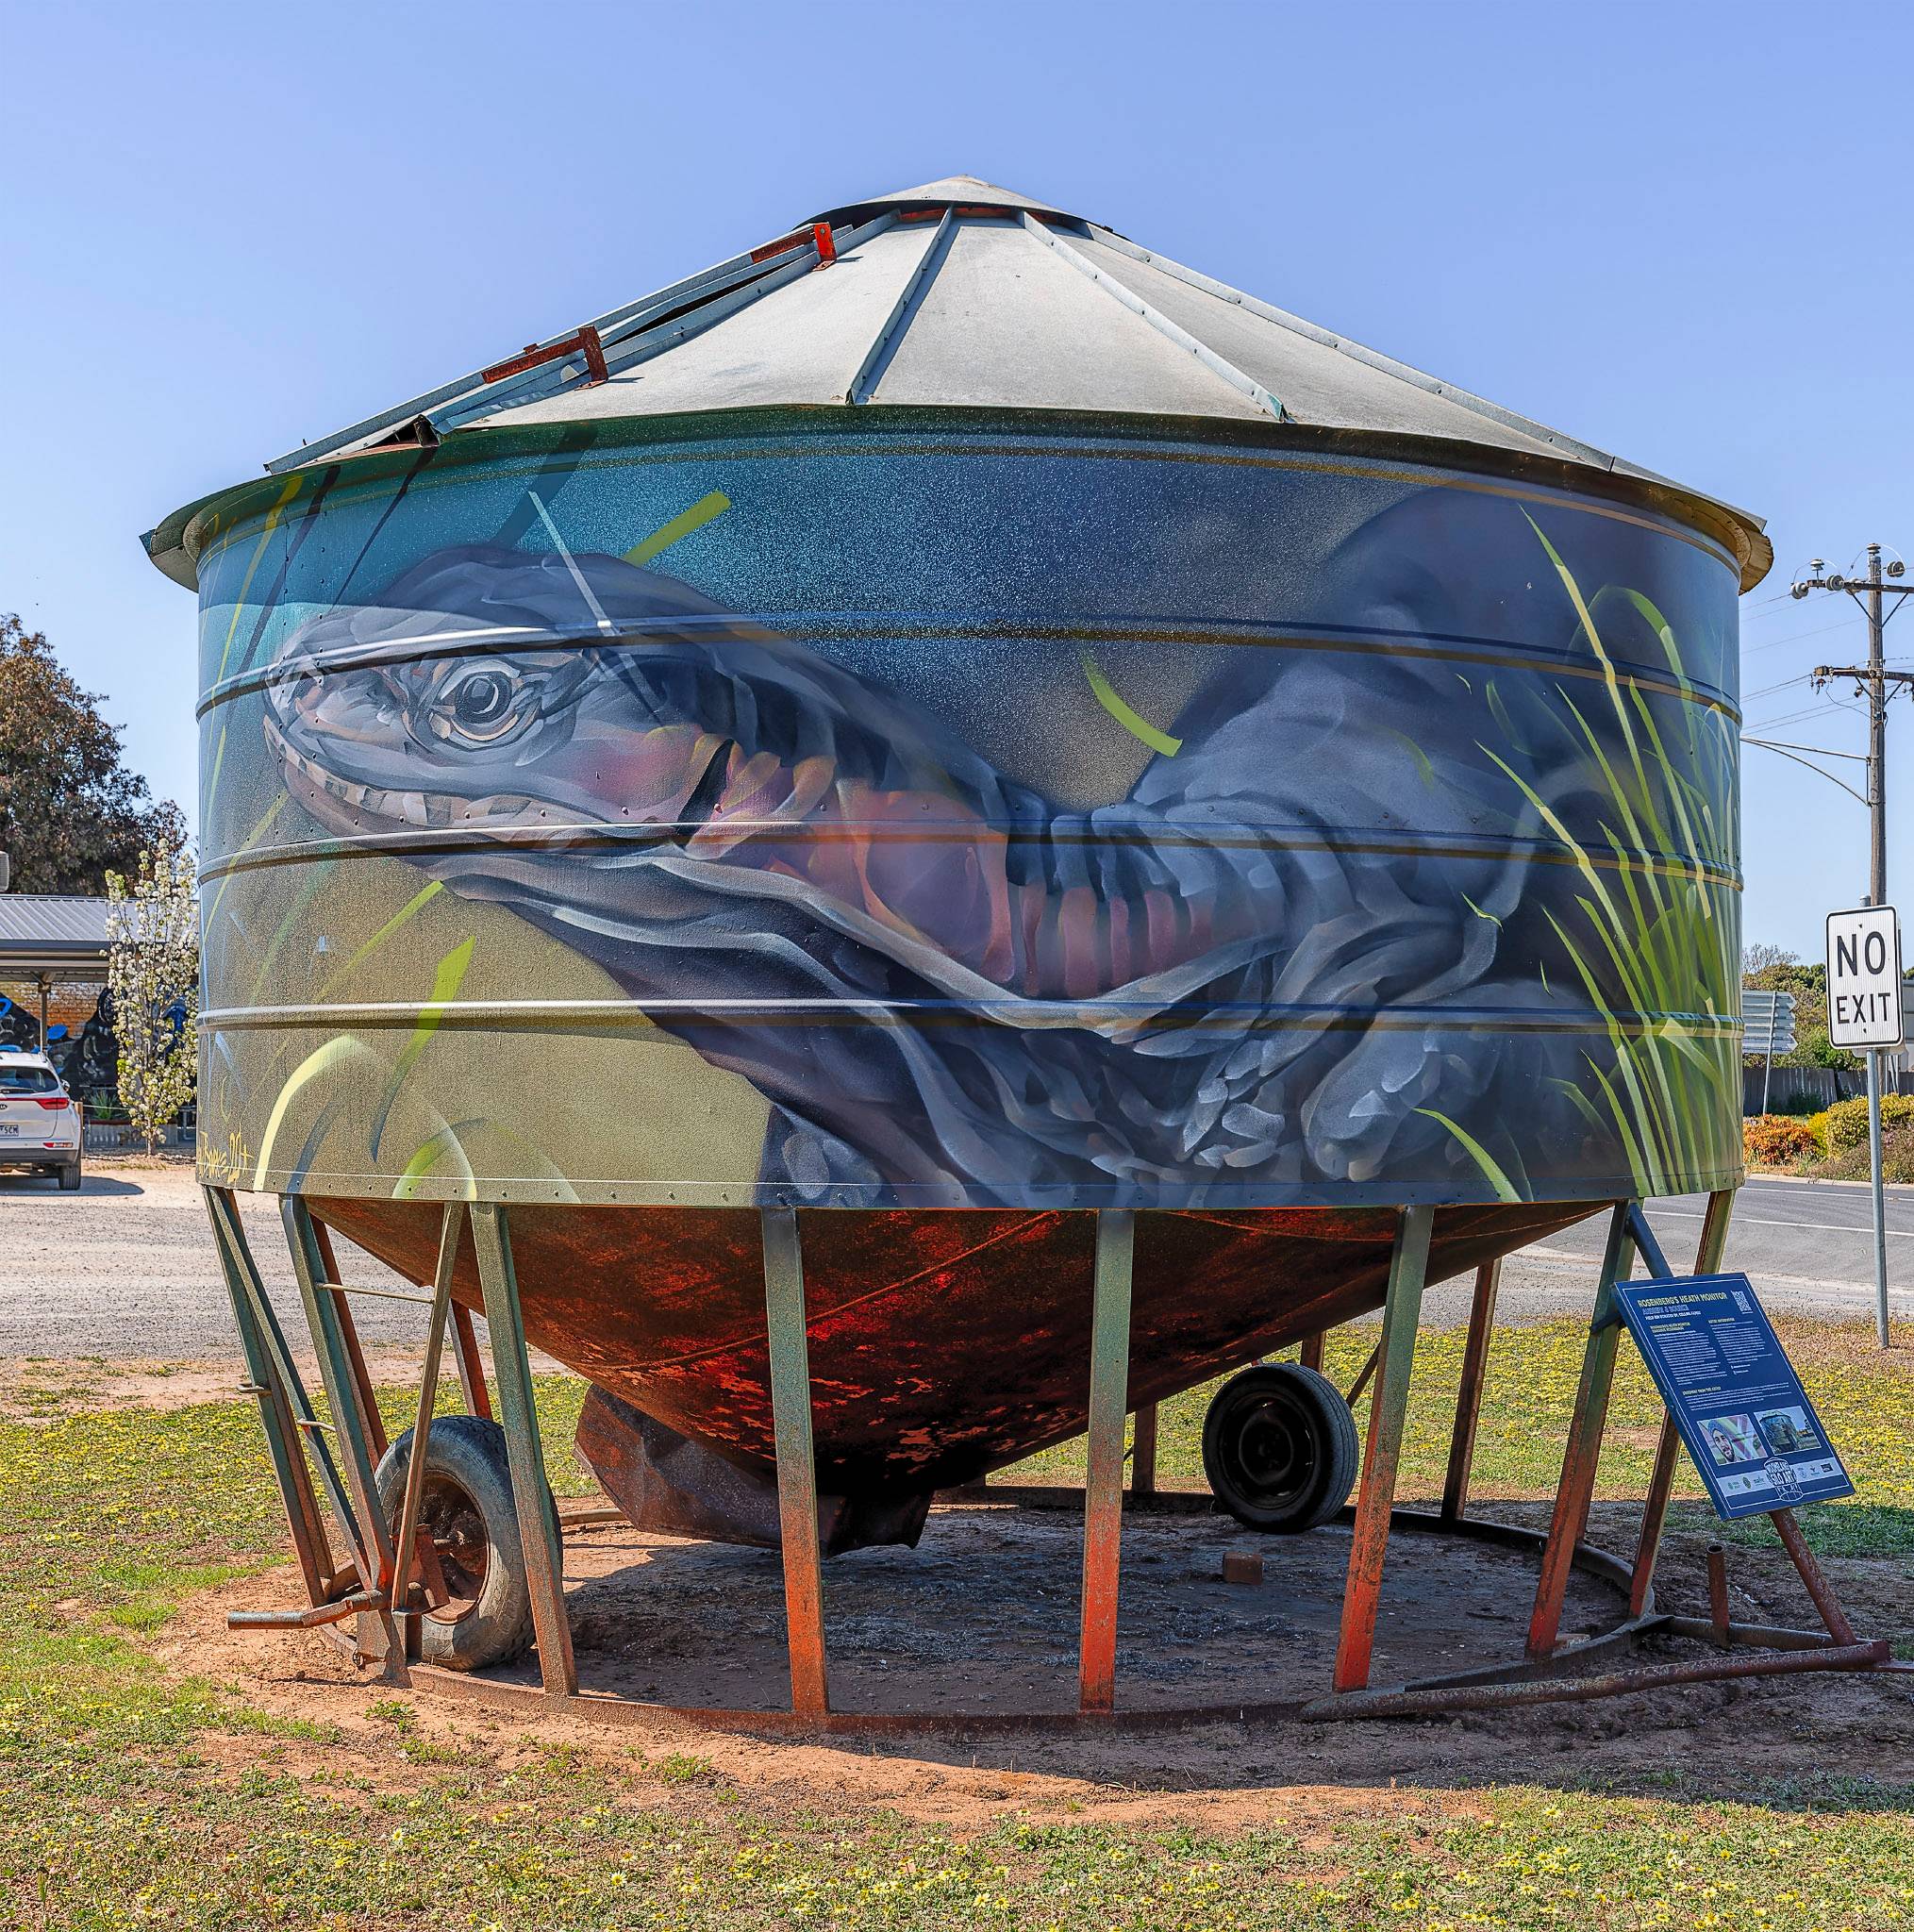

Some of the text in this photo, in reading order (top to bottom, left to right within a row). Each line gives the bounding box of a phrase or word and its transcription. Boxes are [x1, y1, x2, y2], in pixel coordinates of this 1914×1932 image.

[1837, 930, 1886, 977] NO
[1836, 992, 1890, 1024] EXIT
[1637, 1291, 1728, 1307] ROSENBERG'S HEATH MONITOR
